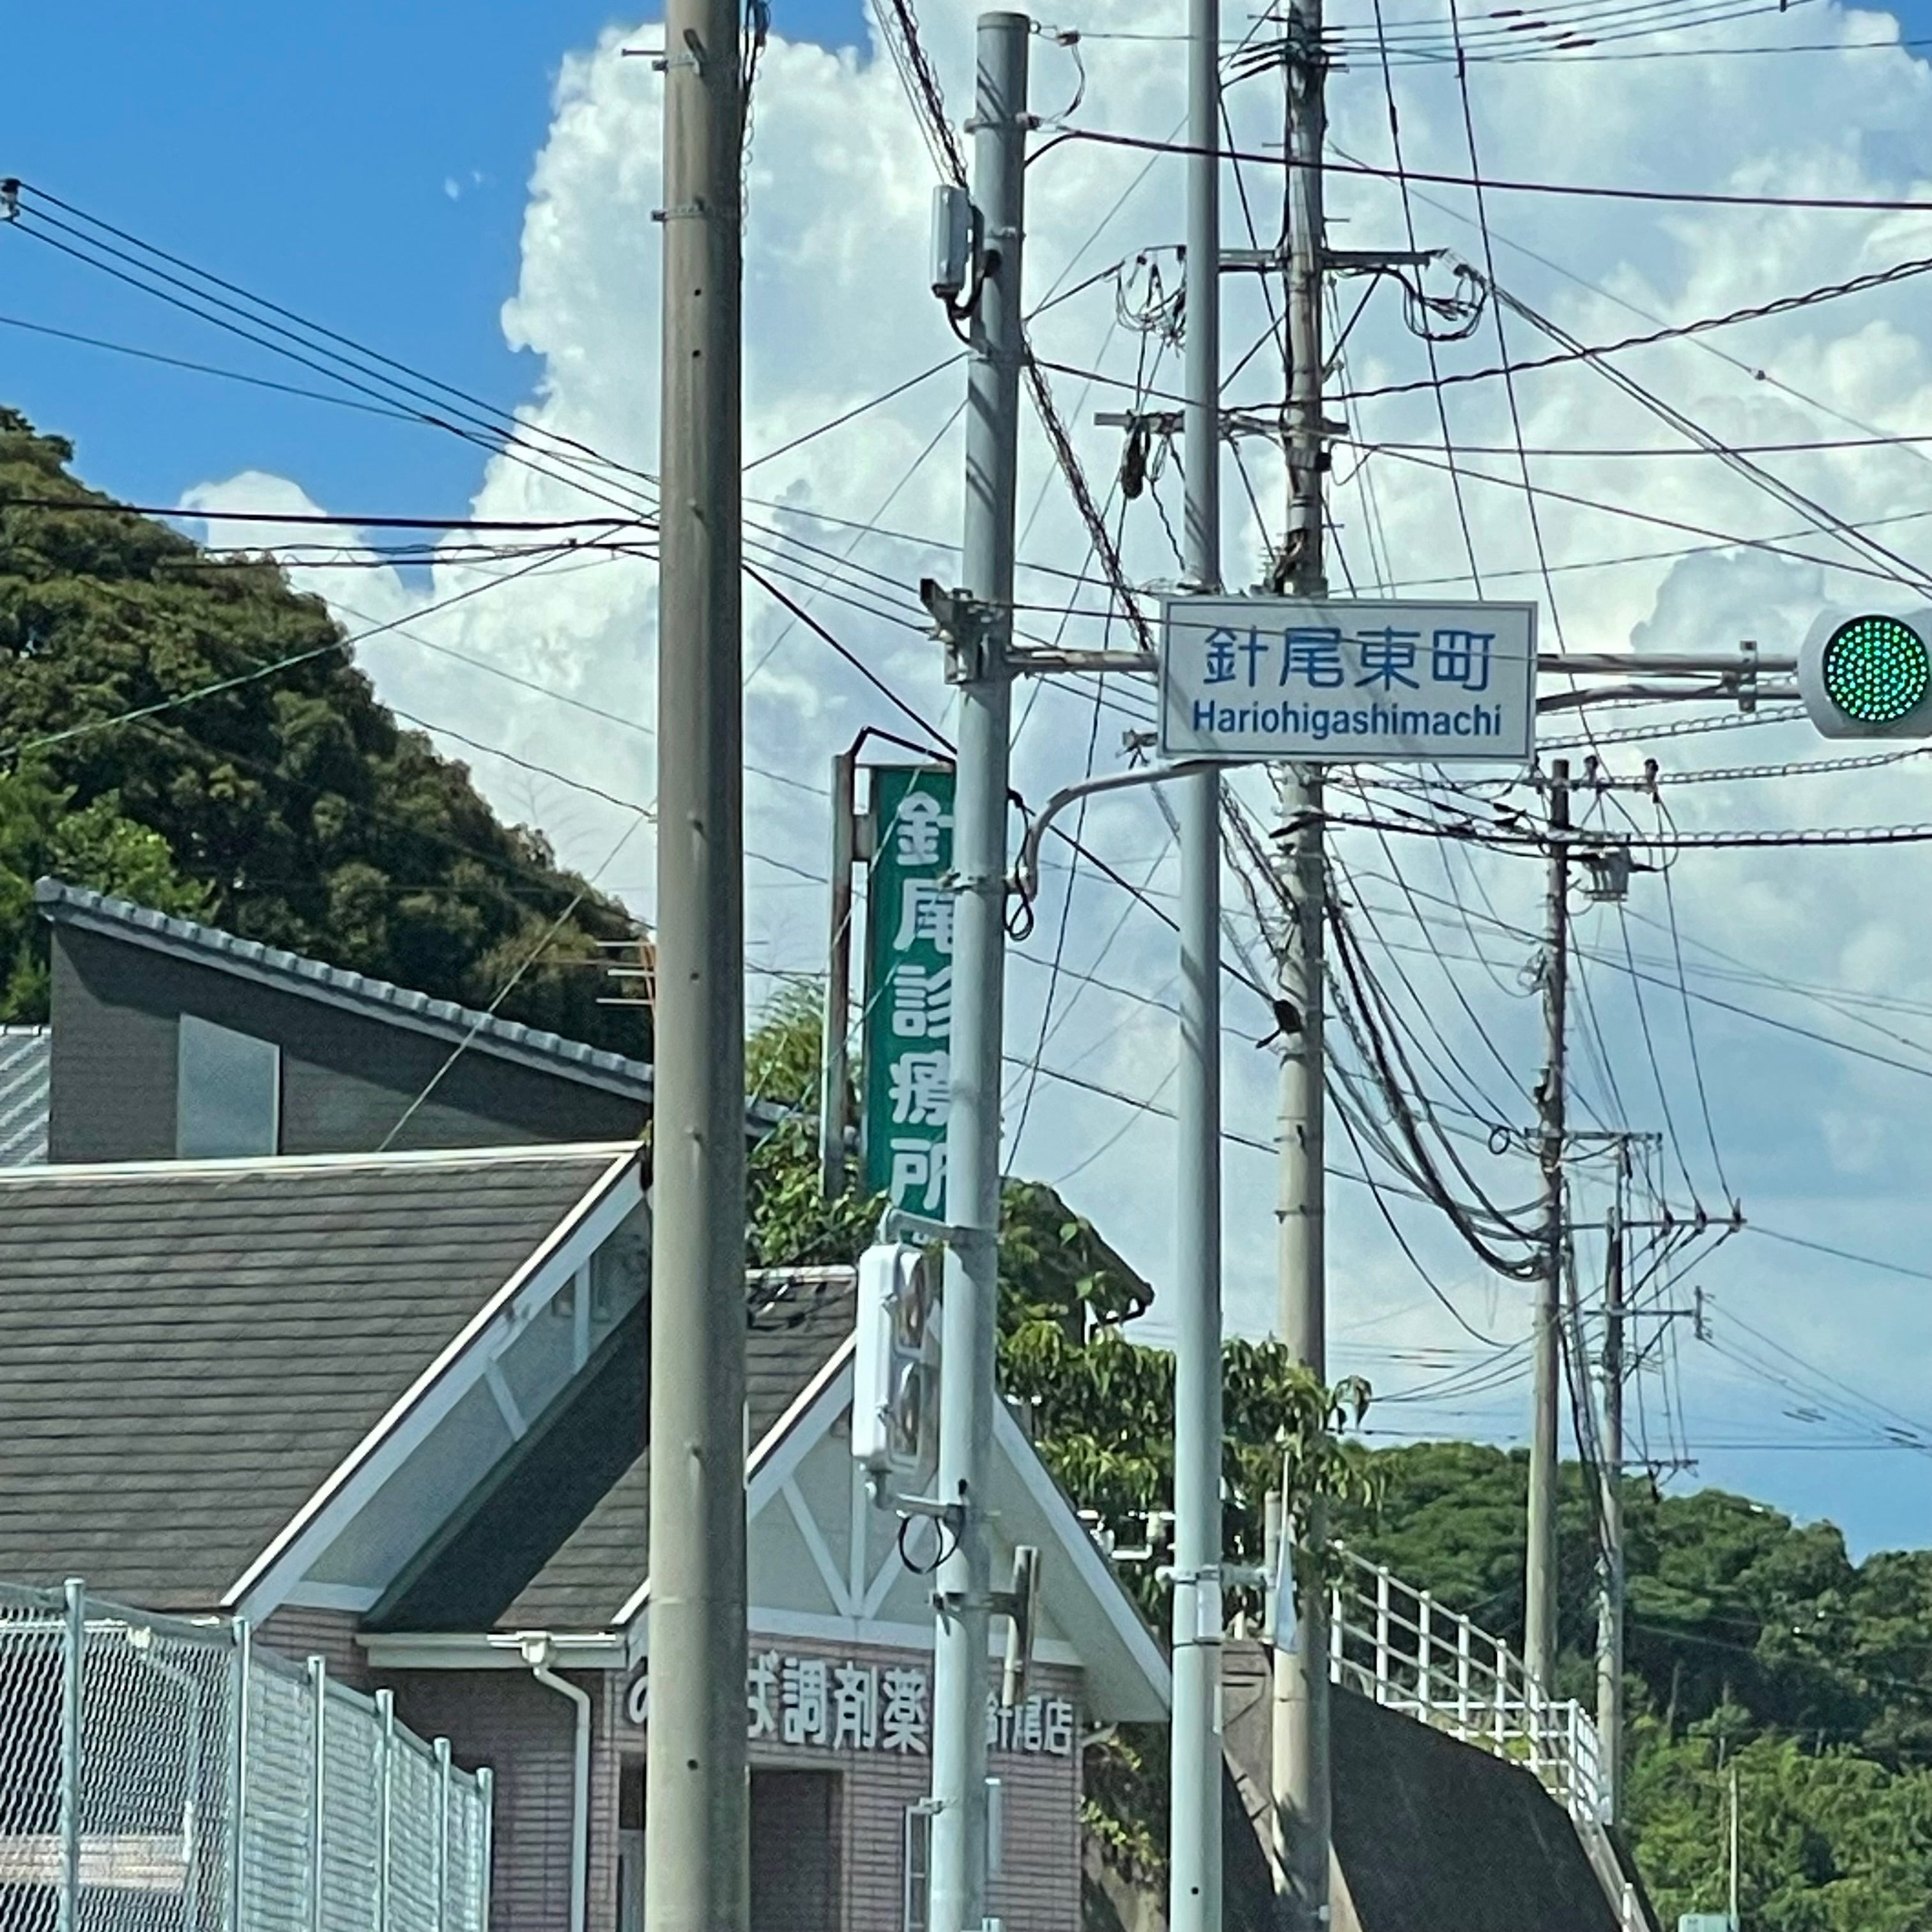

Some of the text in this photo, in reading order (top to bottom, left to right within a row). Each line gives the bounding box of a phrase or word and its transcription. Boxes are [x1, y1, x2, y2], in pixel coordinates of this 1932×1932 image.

[1203, 625, 1496, 691] 針尾東町
[1193, 701, 1501, 740] Hariohigashimachi
